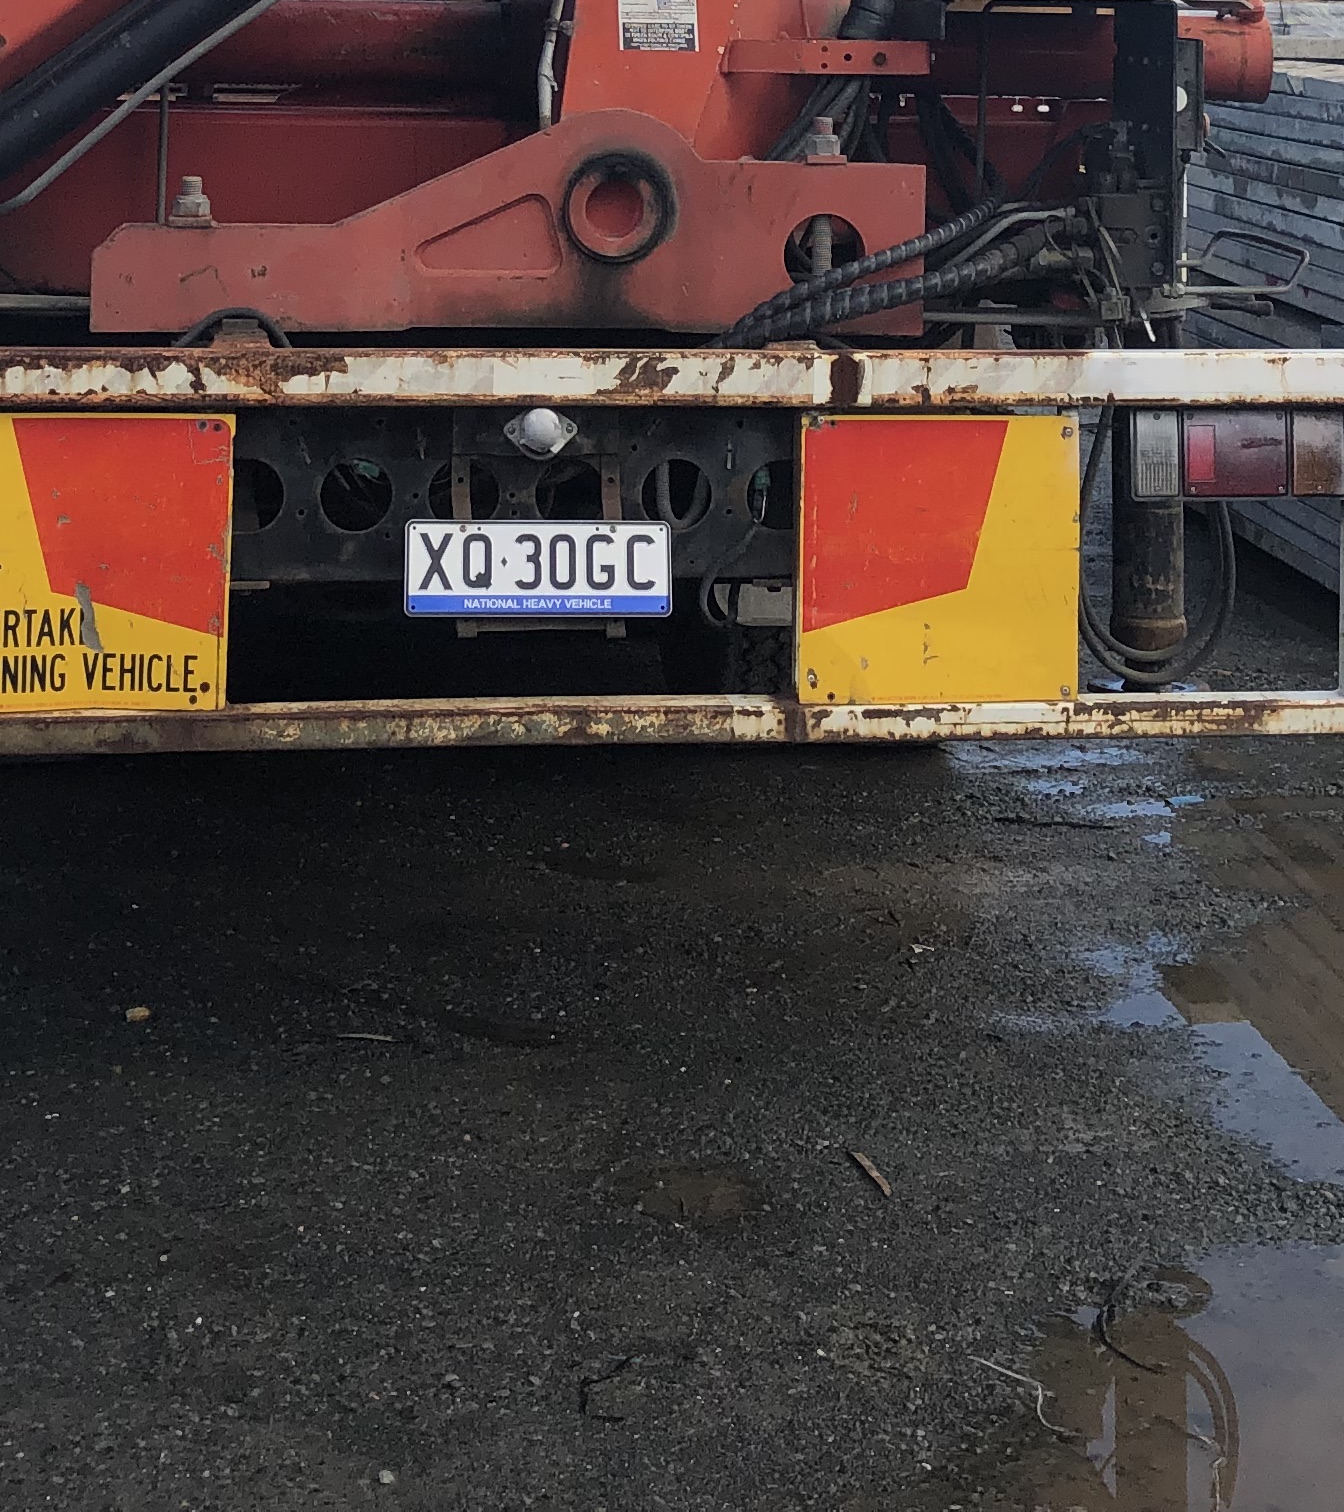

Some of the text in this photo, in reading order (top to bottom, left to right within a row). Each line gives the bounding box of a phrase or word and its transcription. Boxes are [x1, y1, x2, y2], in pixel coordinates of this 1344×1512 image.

[463, 599, 612, 609] NATIONAL HEAVY VEHICLE
